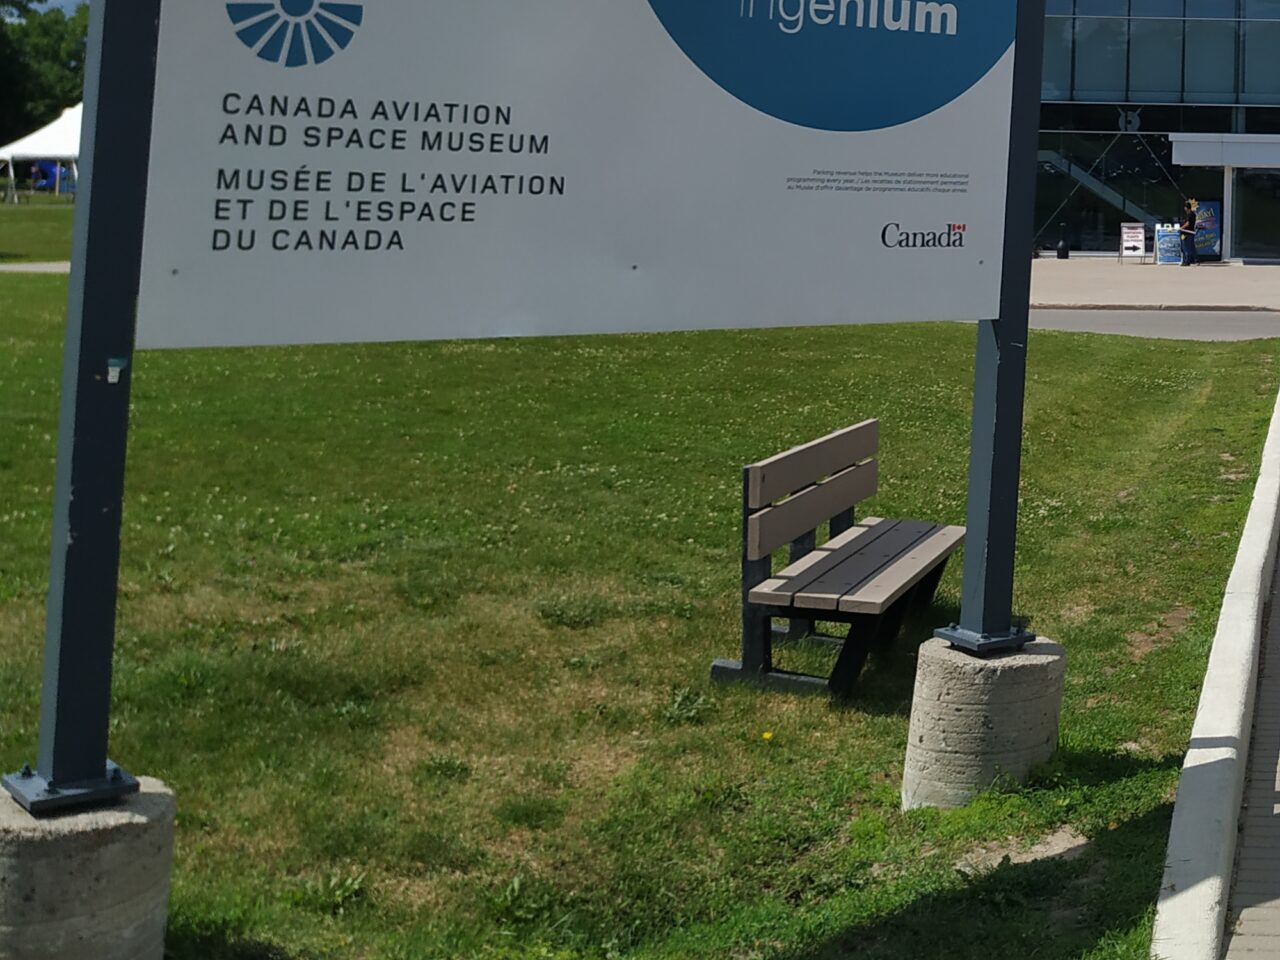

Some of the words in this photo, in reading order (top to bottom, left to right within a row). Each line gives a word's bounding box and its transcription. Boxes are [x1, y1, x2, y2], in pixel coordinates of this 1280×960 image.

[222, 92, 359, 120] CANADA
[370, 100, 512, 126] AVIATION
[218, 123, 287, 147] AND
[303, 126, 408, 151] SPACE
[420, 130, 549, 155] MUSEUM
[216, 164, 333, 192] MUSÉE
[346, 171, 387, 193] DE
[400, 172, 565, 196] L'AVIATION
[214, 198, 255, 221] ET
[267, 199, 310, 222] DE
[324, 199, 476, 223] L'ESPACE
[211, 228, 256, 252] DU
[271, 228, 405, 252] CANADA
[881, 222, 965, 248] Canada
